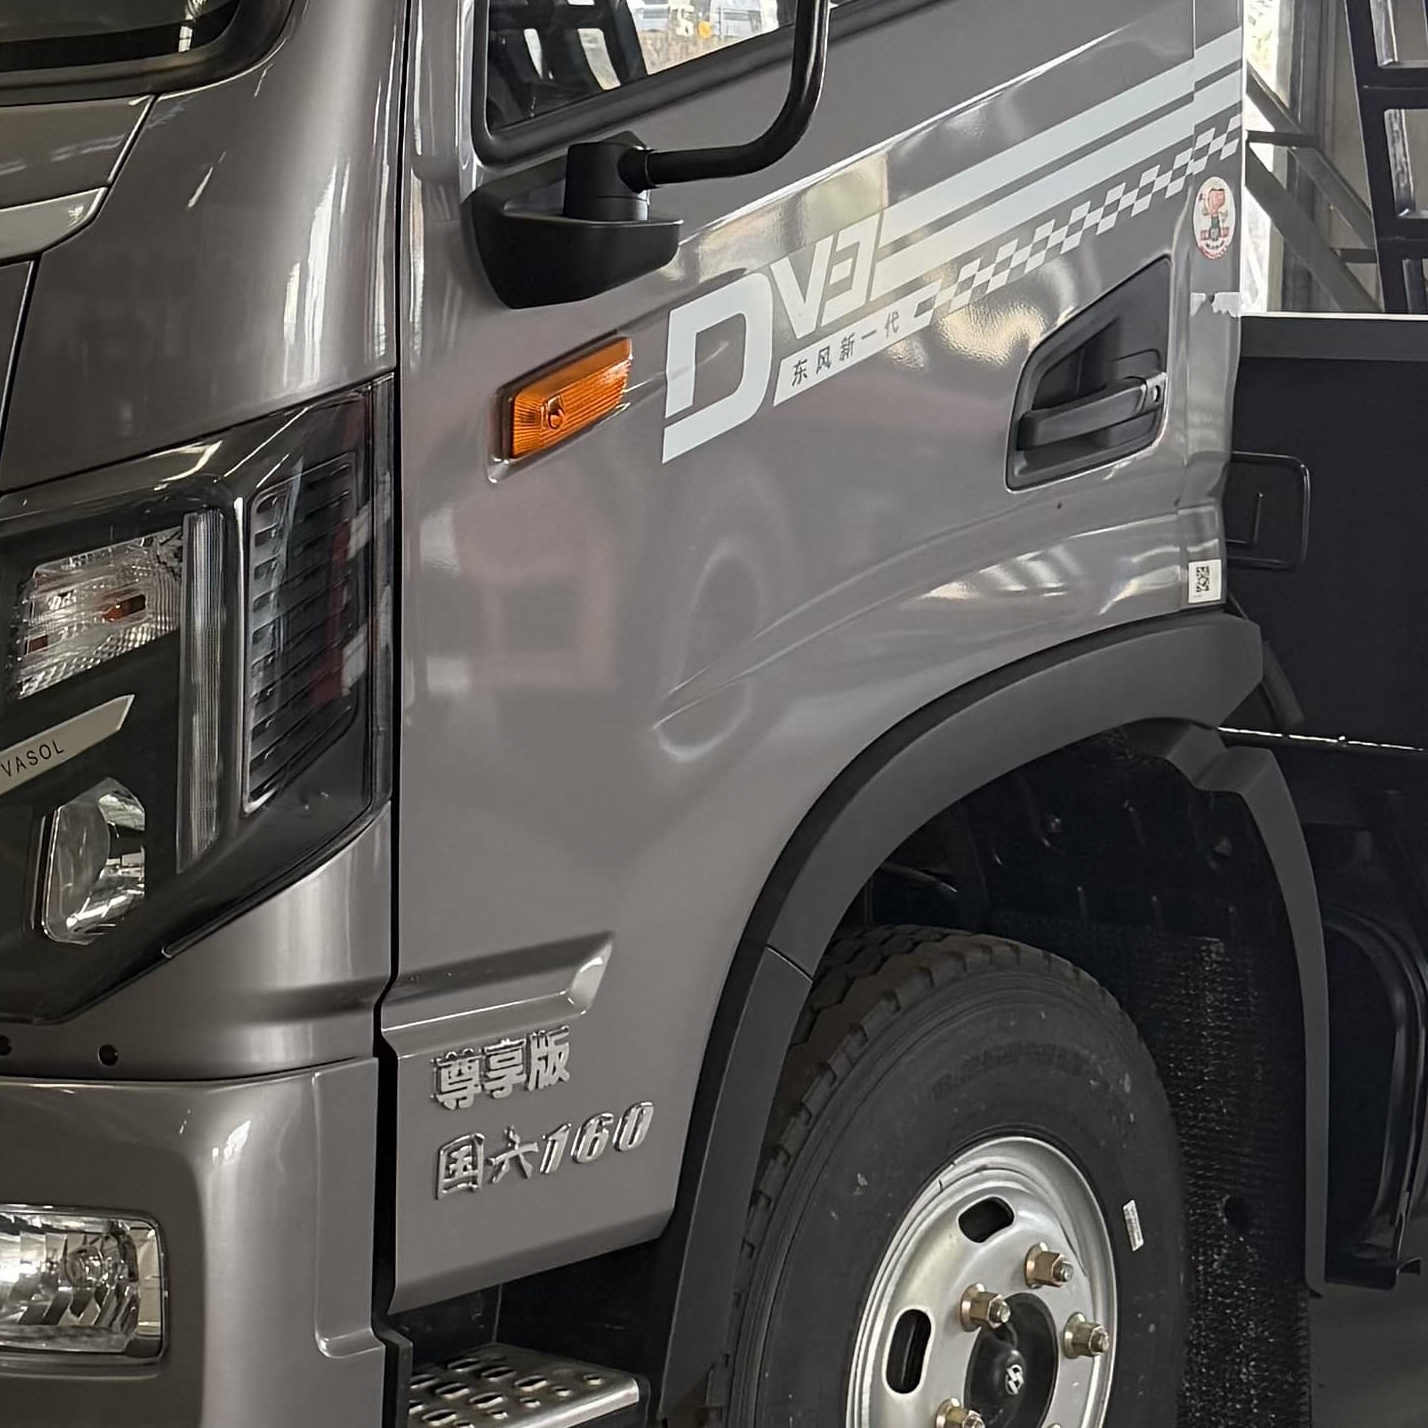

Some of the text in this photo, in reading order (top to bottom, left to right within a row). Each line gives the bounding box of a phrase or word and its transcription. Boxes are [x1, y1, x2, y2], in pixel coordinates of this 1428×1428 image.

[662, 212, 881, 464] DV3
[791, 310, 901, 387] 东风新一代
[0, 739, 65, 778] VASOL
[431, 1025, 571, 1110] 尊享版
[435, 1100, 655, 1201] 国六160
